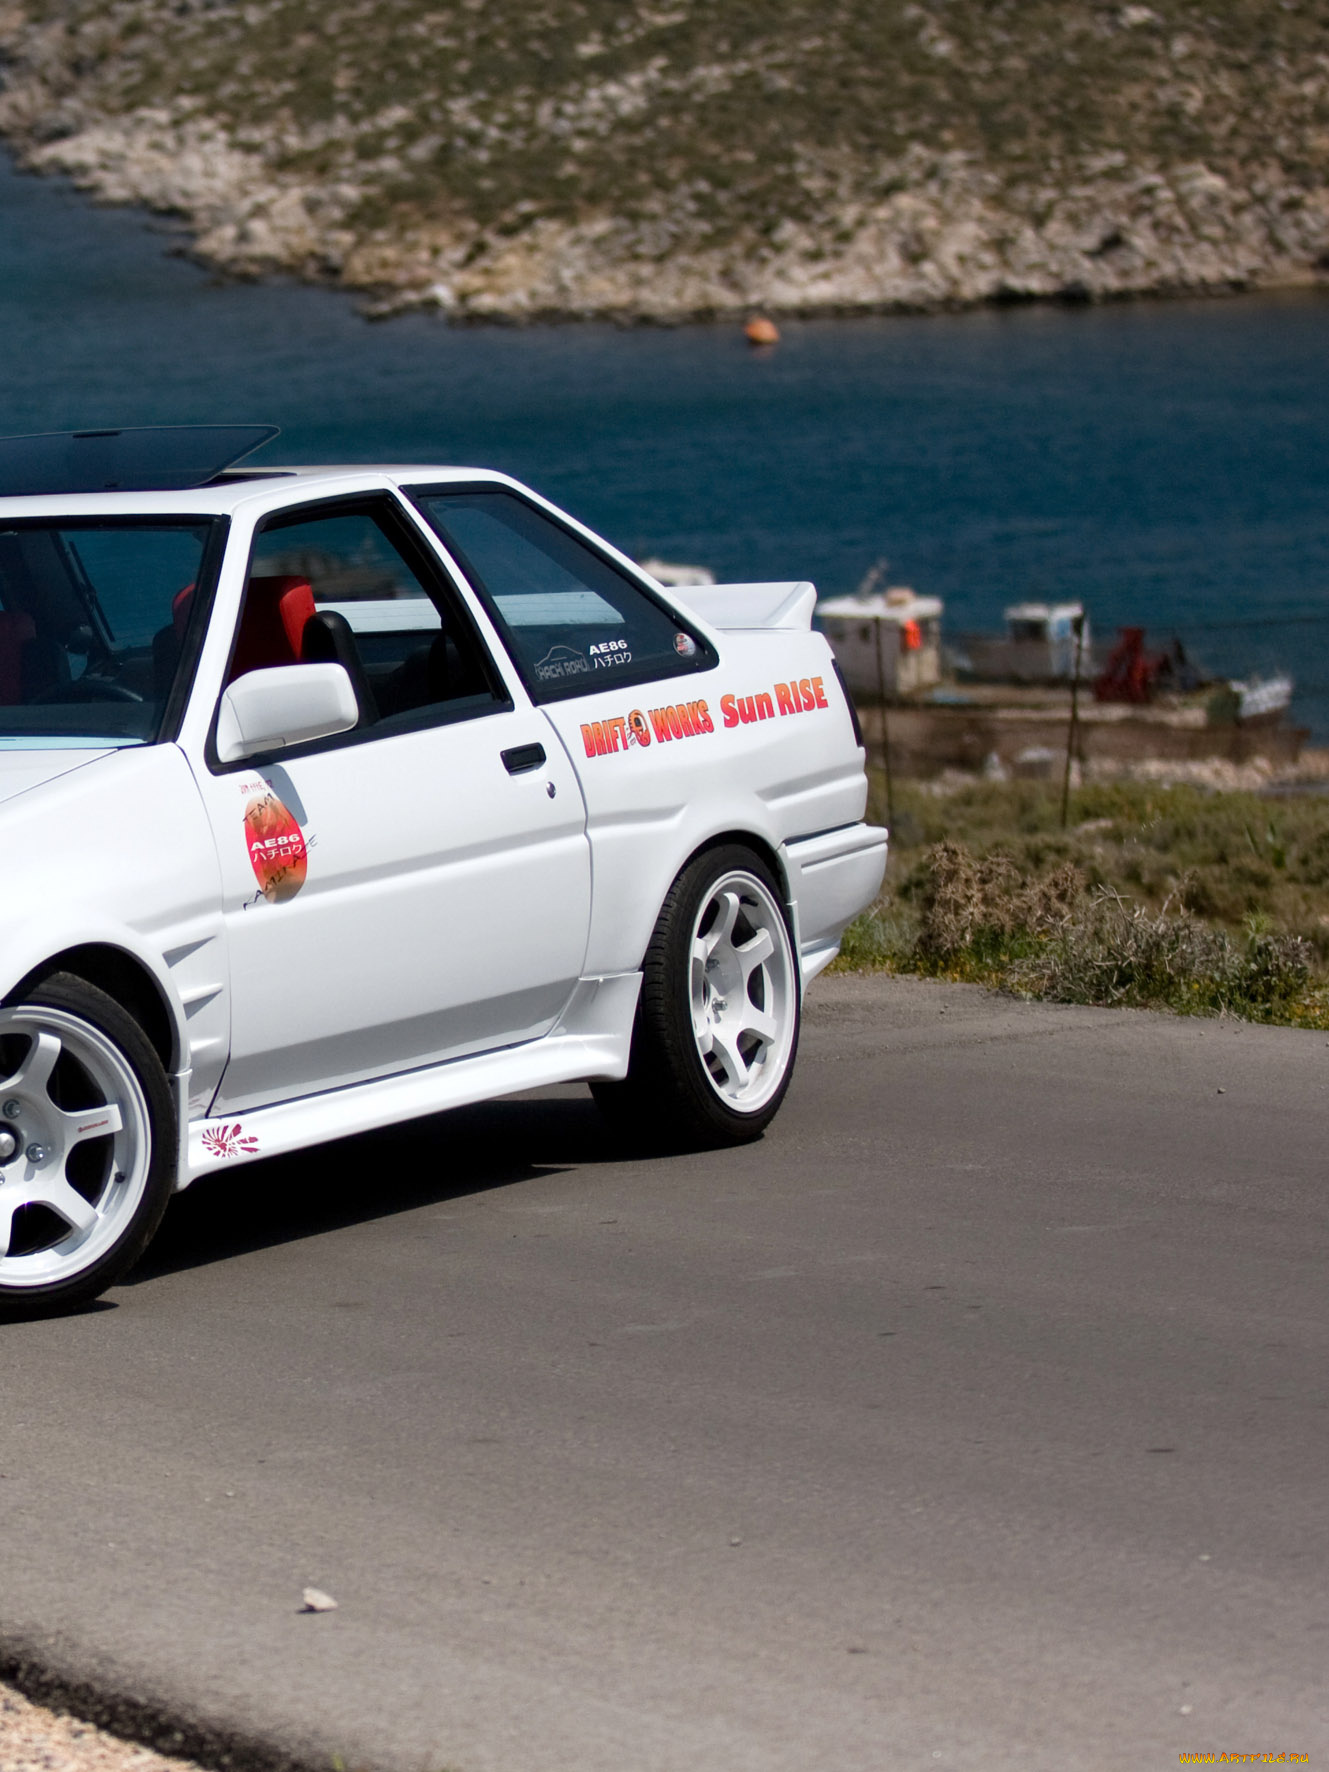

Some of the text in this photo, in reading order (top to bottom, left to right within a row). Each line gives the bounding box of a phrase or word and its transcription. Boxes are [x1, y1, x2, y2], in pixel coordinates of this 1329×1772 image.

[589, 640, 628, 656] AE86
[593, 652, 632, 669] ハチロク
[719, 676, 829, 728] Sun RISE
[579, 699, 715, 758] DRIFT WORKS
[251, 833, 301, 852] AE86
[253, 844, 303, 863] ハチロク
